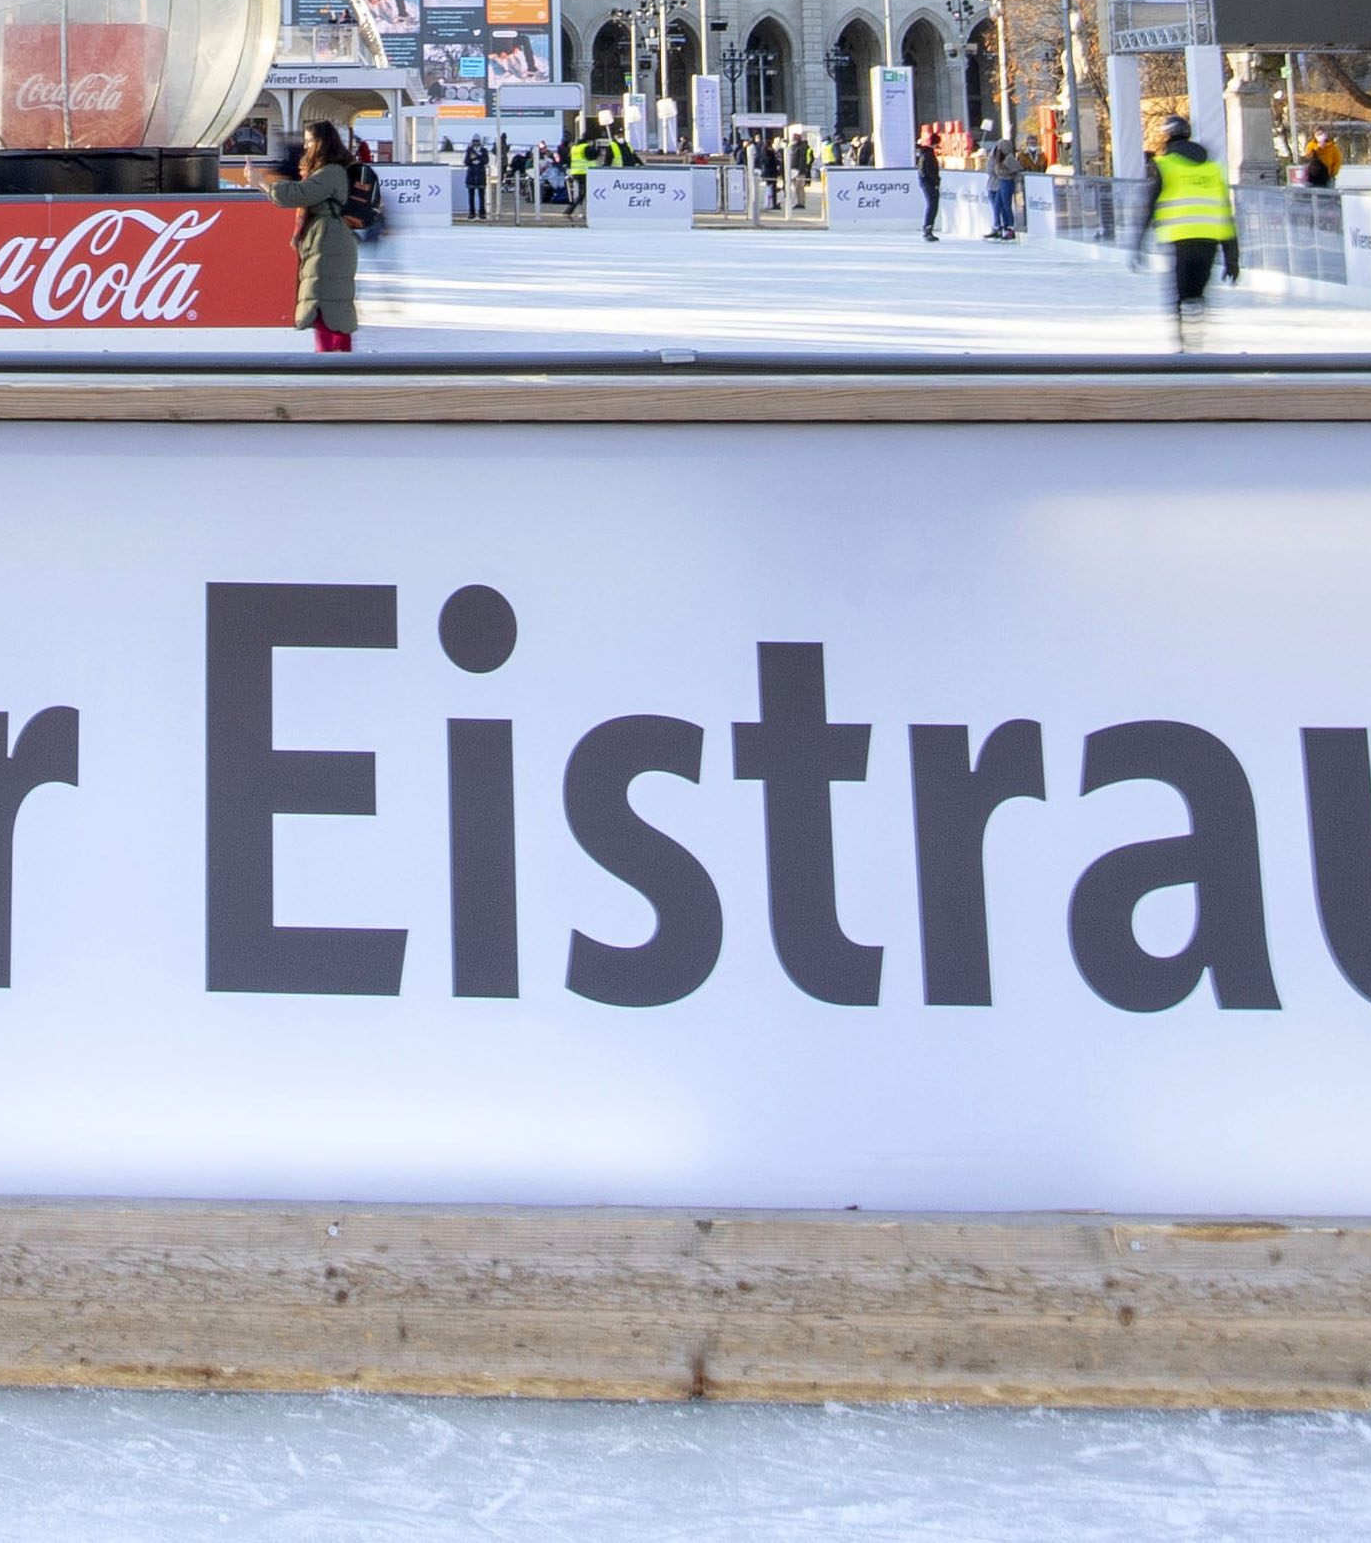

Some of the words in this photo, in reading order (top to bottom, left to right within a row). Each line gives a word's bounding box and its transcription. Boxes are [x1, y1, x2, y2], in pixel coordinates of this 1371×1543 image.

[299, 72, 339, 84] Eistraum
[378, 178, 421, 190] usgang
[613, 179, 666, 194] Ausgang
[857, 181, 910, 194] Ausgang
[398, 192, 421, 204] Exit
[628, 196, 651, 208] Exit
[858, 197, 880, 208] Exit
